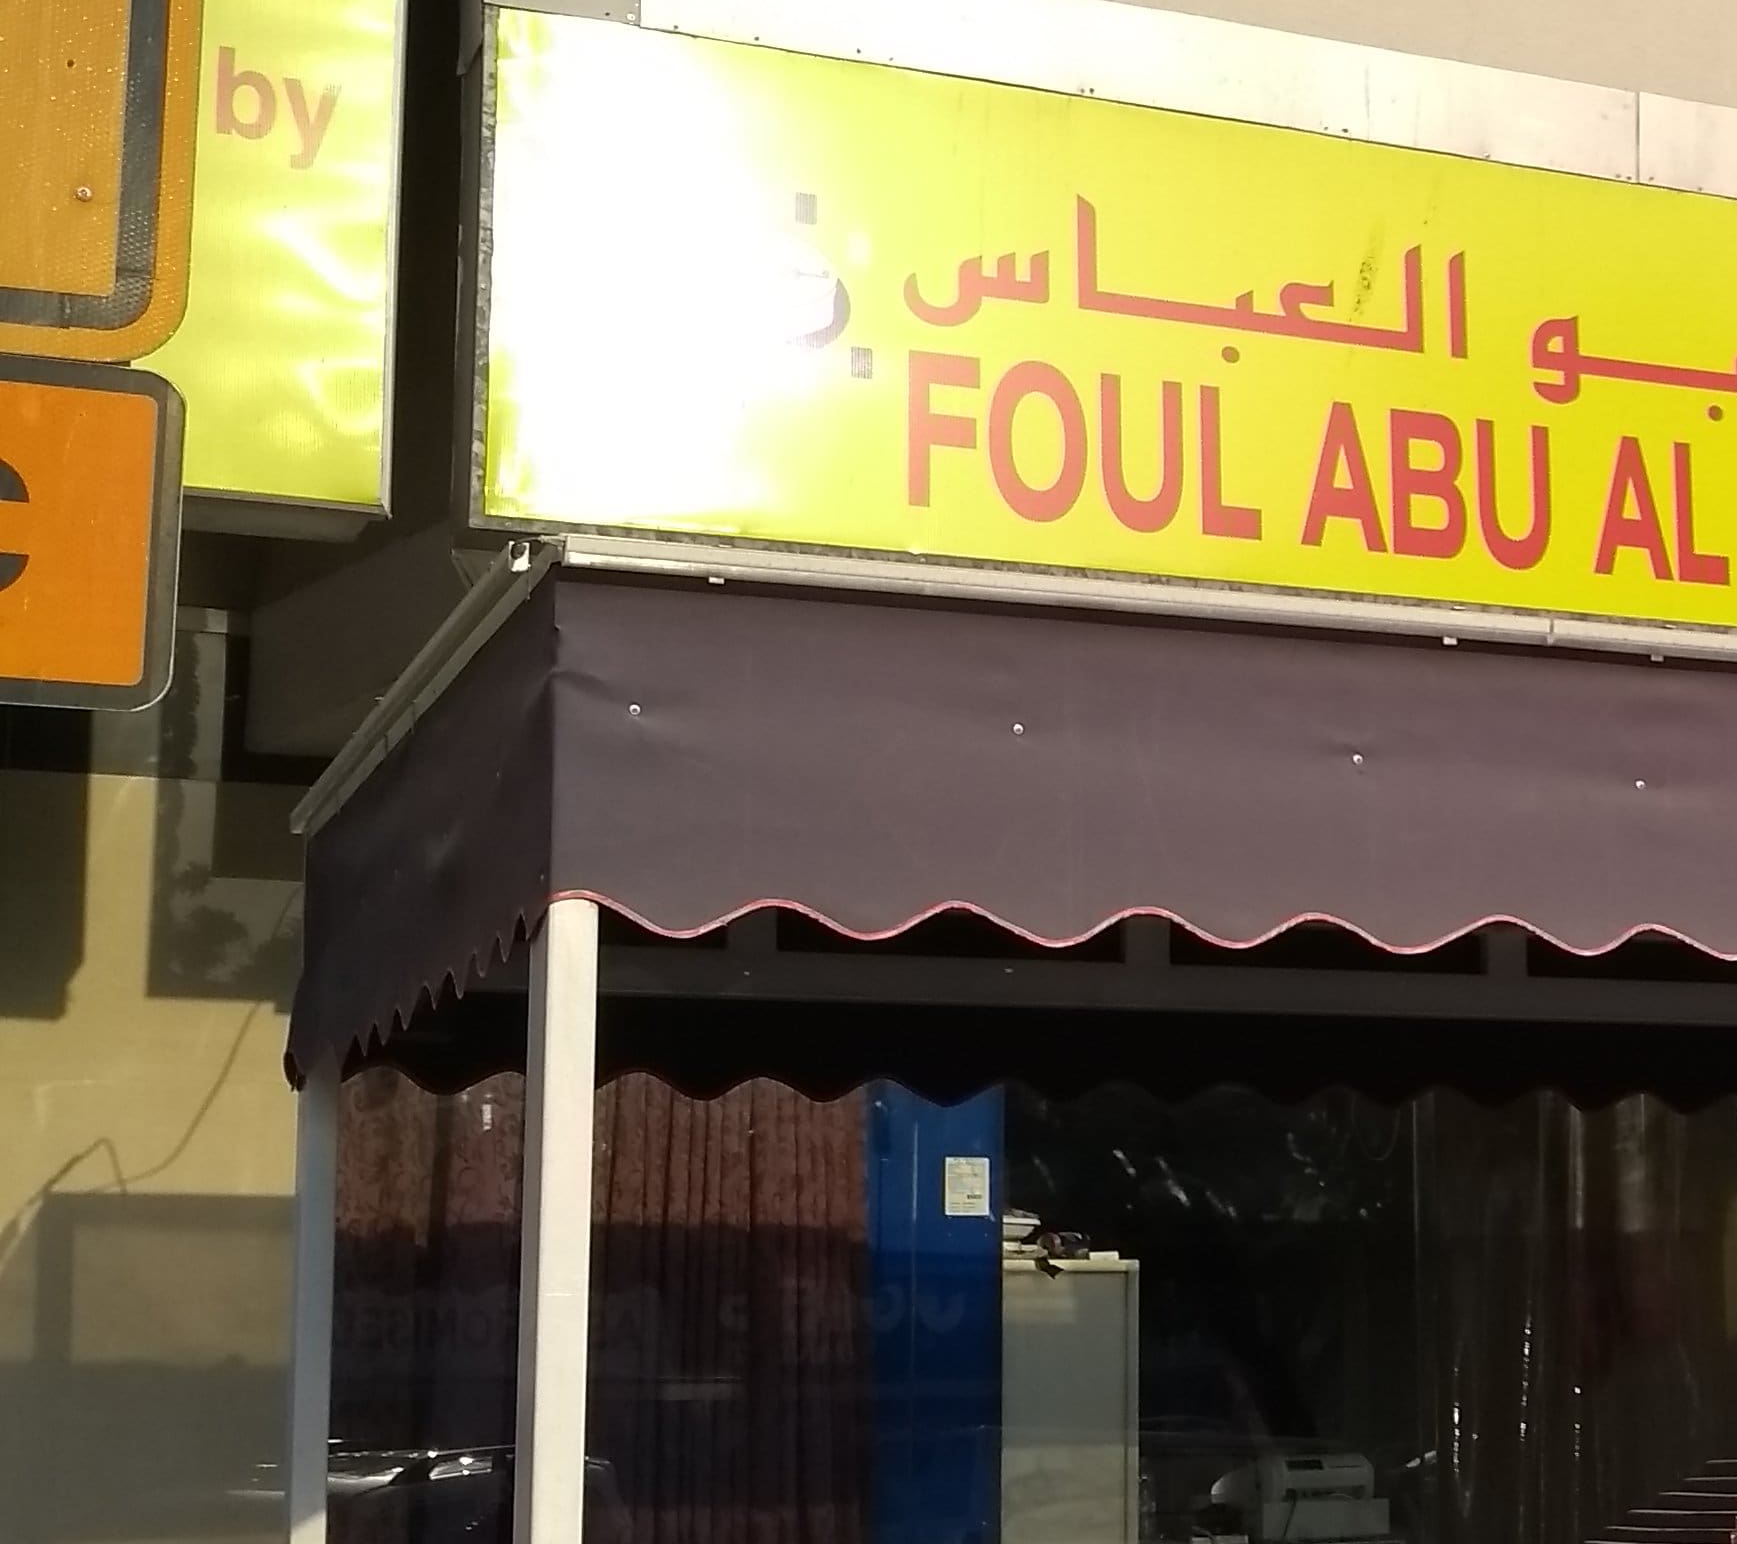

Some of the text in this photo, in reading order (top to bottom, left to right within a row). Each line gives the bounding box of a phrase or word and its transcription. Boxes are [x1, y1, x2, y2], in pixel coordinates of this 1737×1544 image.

[903, 194, 1469, 364] العباس
[908, 349, 1263, 540] FOUL
[1300, 401, 1551, 570] ABU
[1594, 436, 1731, 586] AL
